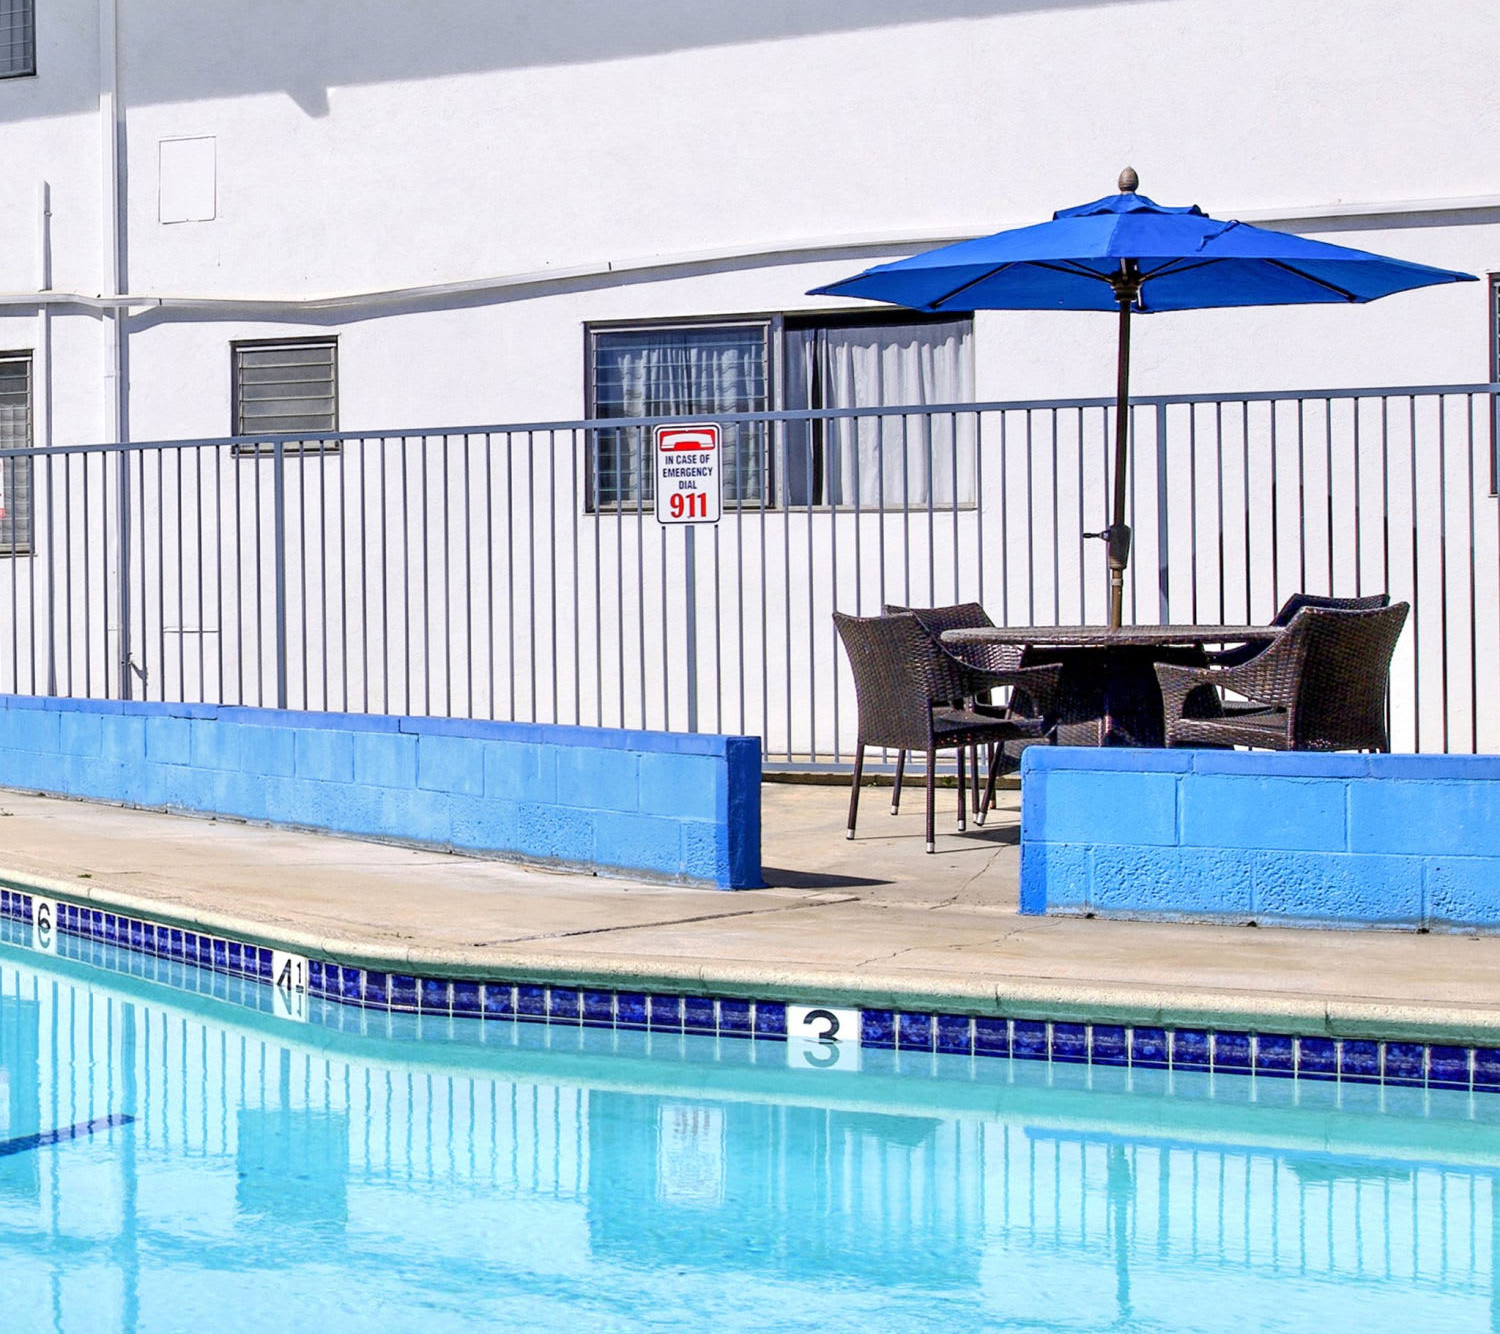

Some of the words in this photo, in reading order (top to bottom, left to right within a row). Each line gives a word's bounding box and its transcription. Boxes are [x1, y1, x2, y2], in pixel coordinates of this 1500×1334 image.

[665, 455, 674, 464] IN
[676, 454, 697, 464] CASE
[700, 454, 710, 464] OF
[662, 467, 713, 478] EMERGENCY
[679, 480, 697, 489] DIAL
[670, 492, 707, 518] 911
[38, 903, 51, 930] 6
[803, 1009, 840, 1043] 3
